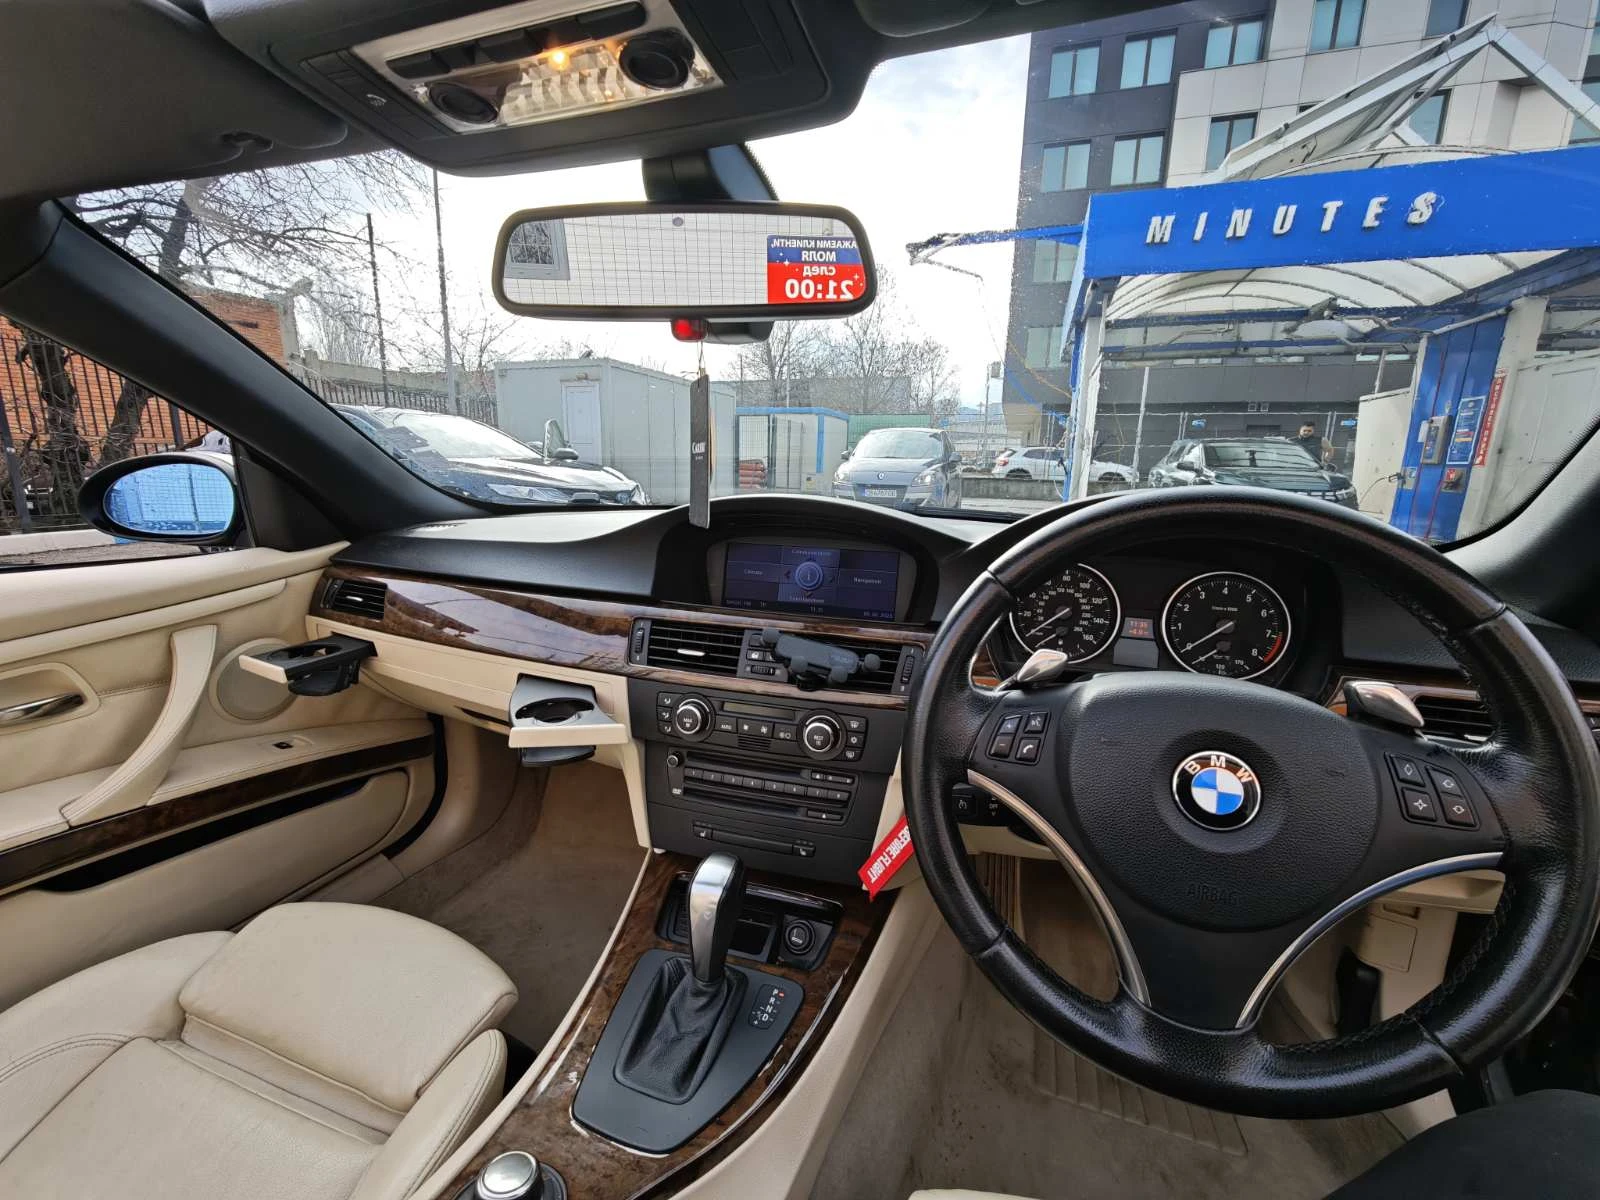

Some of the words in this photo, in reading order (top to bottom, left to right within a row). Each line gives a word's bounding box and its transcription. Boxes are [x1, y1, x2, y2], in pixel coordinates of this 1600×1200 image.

[1145, 191, 1437, 245] MINUTES
[1222, 587, 1229, 595] 4
[1199, 591, 1206, 600] 3
[1183, 604, 1190, 612] 2
[1261, 609, 1268, 618] 6
[1265, 629, 1272, 637] 7
[1251, 648, 1258, 656] 8
[1184, 755, 1253, 784] BMW
[772, 988, 779, 996] P
[769, 996, 776, 1005] R
[765, 1005, 773, 1013] N
[762, 1013, 769, 1021] D
